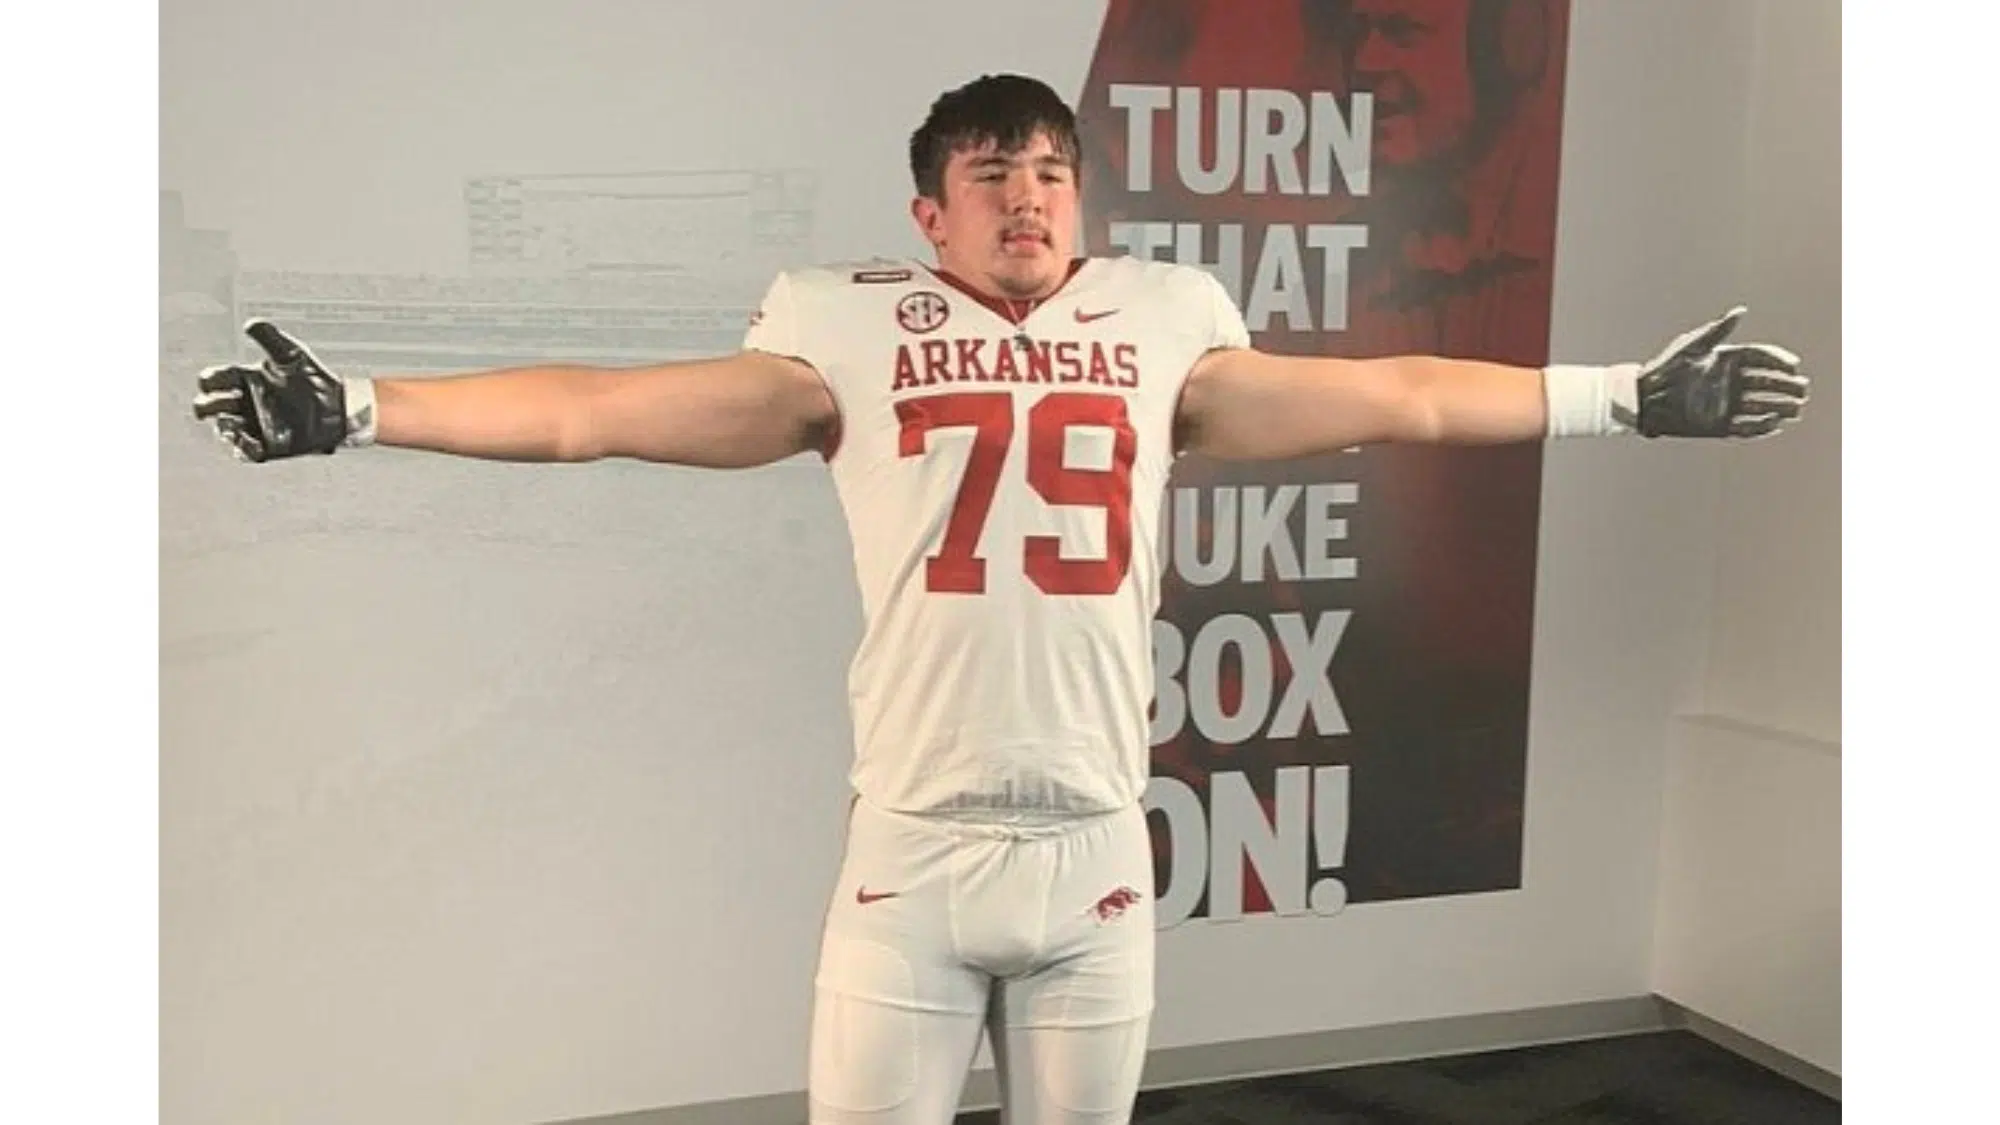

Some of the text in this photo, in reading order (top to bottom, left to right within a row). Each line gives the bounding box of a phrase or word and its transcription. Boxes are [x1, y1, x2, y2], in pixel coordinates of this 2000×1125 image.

[1108, 83, 1374, 196] TURN
[891, 338, 1139, 391] ARKANSAS
[898, 294, 947, 330] SEC
[893, 391, 1138, 596] 79
[1157, 483, 1360, 587] UKE
[1141, 765, 1350, 931] ON!
